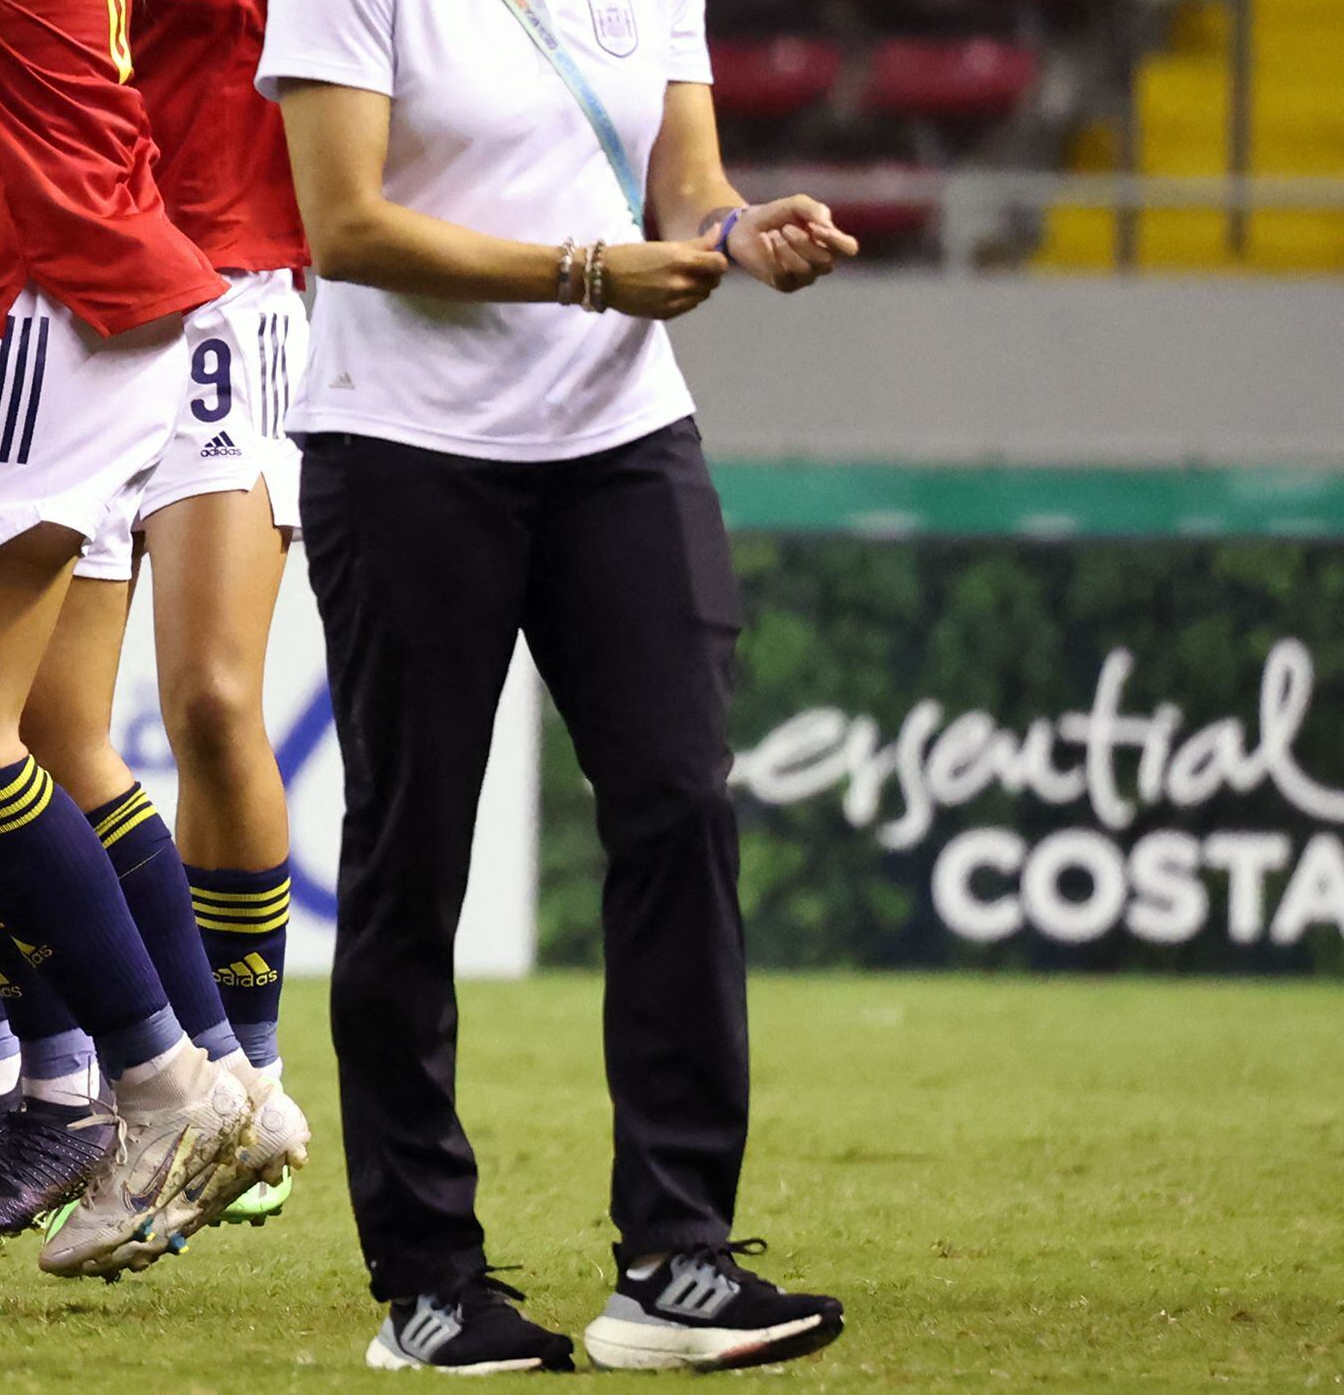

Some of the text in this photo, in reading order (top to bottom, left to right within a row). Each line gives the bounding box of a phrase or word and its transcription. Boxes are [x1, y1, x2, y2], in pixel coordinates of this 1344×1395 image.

[190, 338, 232, 423] 9
[200, 446, 242, 458] adidas
[724, 635, 1344, 852] essential
[930, 826, 1344, 946] COSTA
